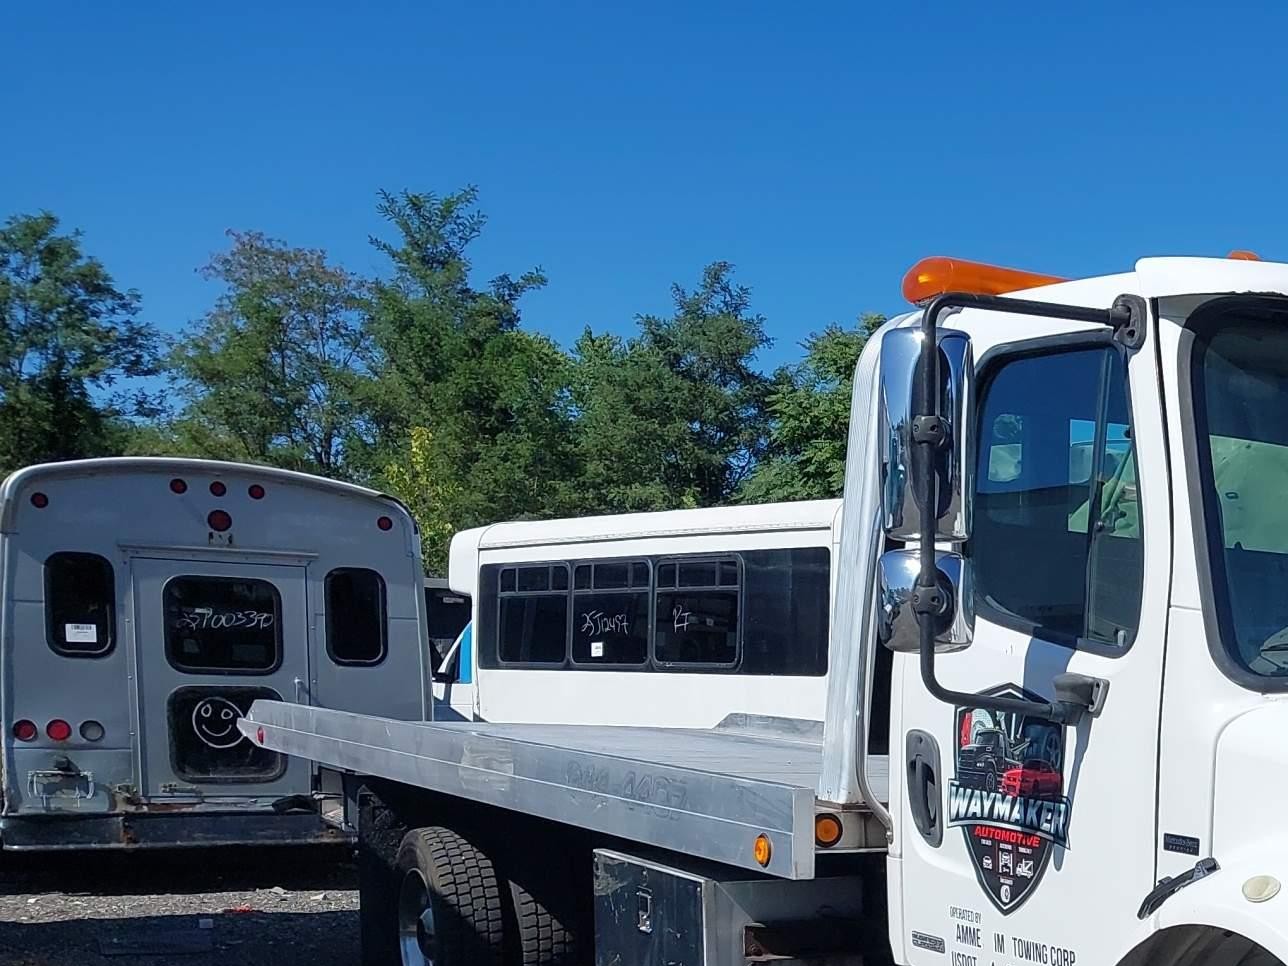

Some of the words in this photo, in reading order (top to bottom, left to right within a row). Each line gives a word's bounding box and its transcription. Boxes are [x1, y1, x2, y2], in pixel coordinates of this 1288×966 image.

[949, 785, 1067, 838] WAYMAKER
[974, 825, 1041, 848] AUTOMOTIVE
[950, 906, 974, 922] OPERATED
[974, 912, 982, 924] BY
[956, 923, 982, 948] AMME
[994, 932, 1005, 954] IM
[1012, 937, 1048, 964] TOWING
